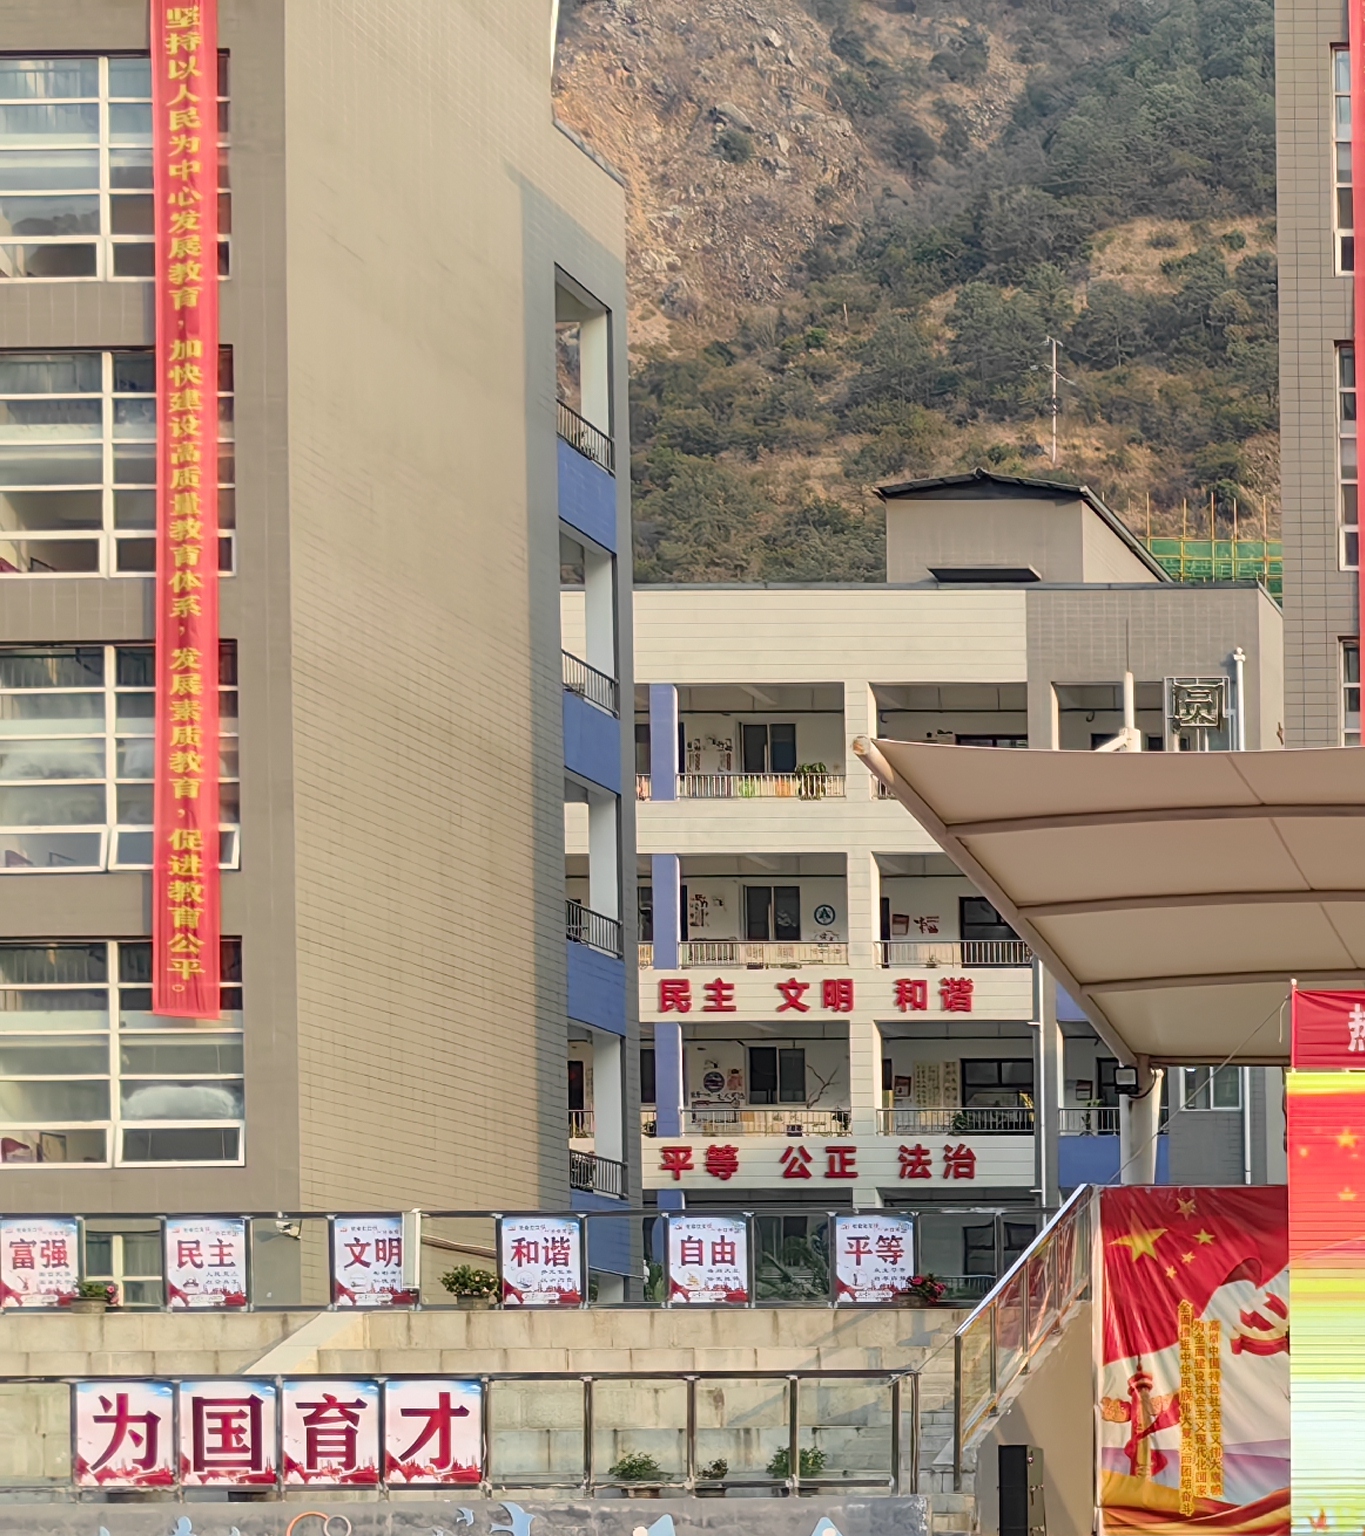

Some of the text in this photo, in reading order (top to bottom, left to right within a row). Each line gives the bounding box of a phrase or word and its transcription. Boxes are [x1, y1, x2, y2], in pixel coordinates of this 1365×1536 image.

[658, 976, 975, 1013] 民主 文明 和谐
[659, 1143, 978, 1180] 平等 公正 法治
[9, 1238, 70, 1270] 富强
[176, 1238, 237, 1270] 民主
[344, 1237, 402, 1269] 文明
[510, 1236, 571, 1268] 和谐
[680, 1235, 736, 1267] 自由
[844, 1234, 905, 1267] 平等
[91, 1392, 470, 1473] 为国育才
